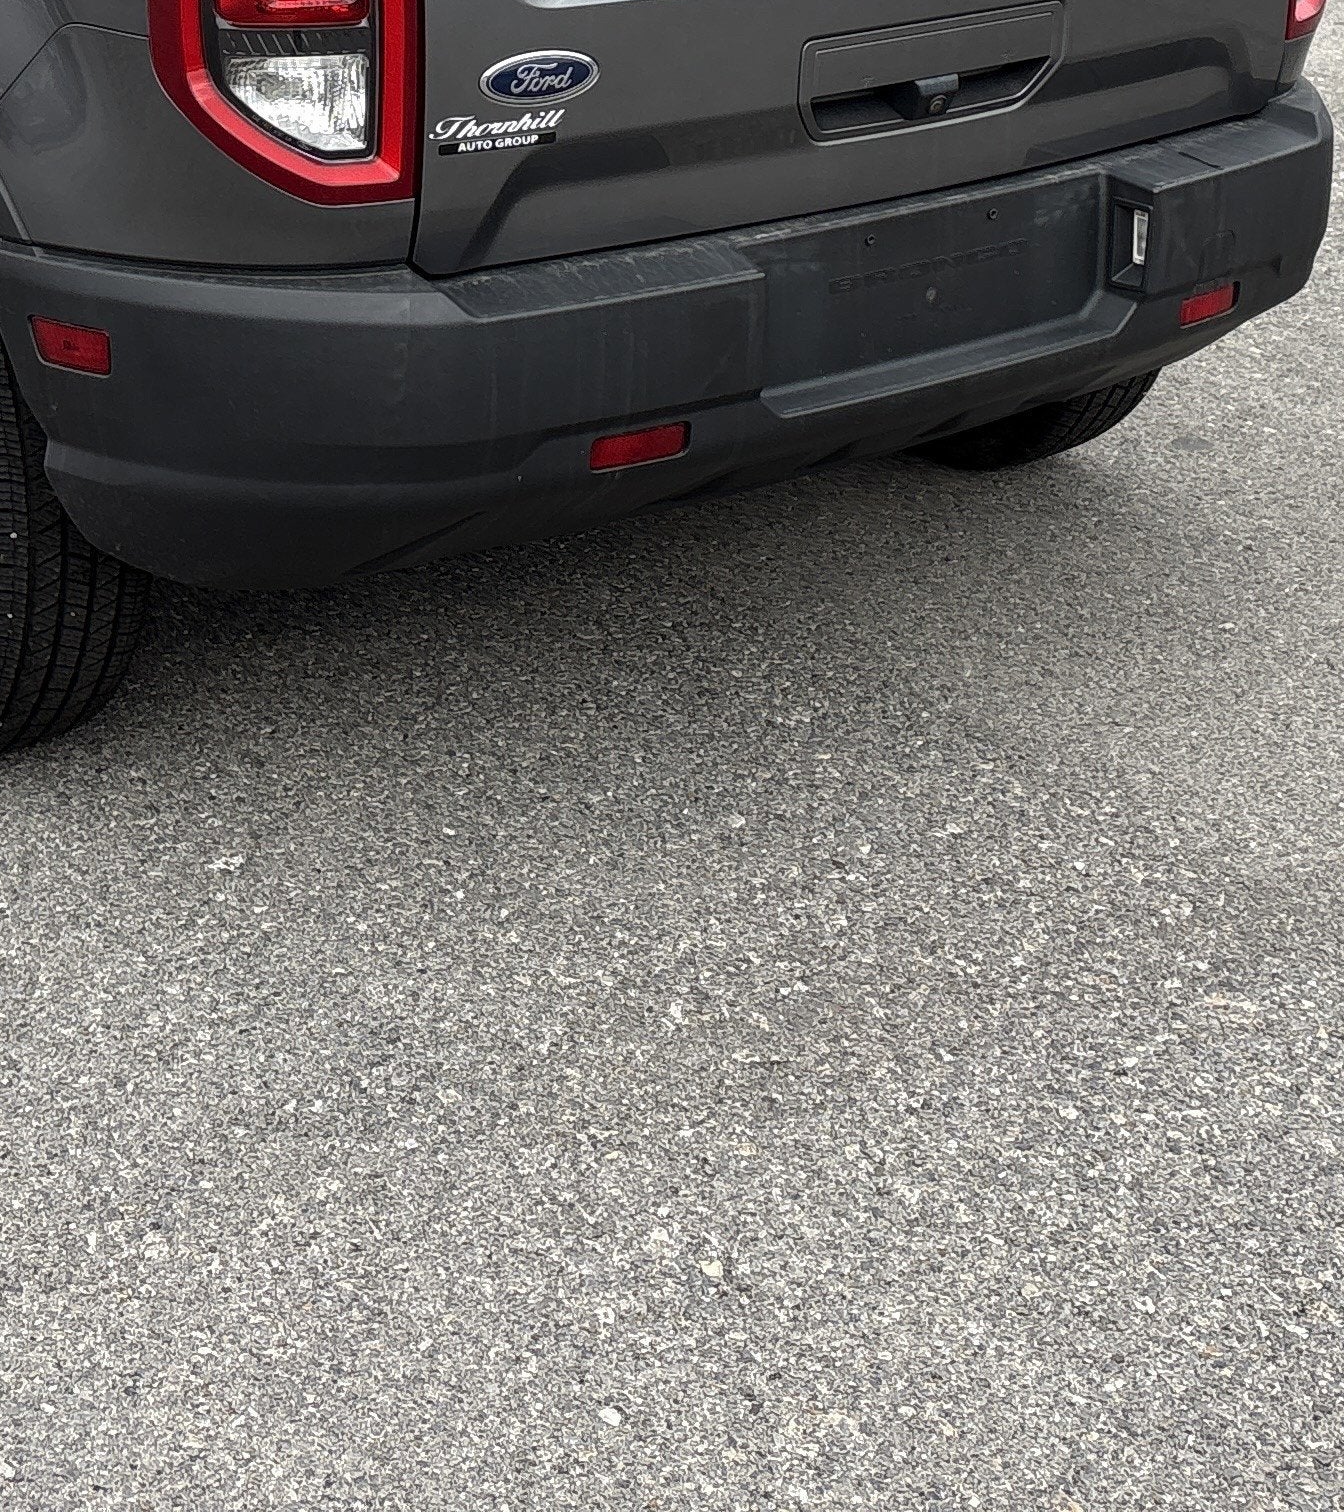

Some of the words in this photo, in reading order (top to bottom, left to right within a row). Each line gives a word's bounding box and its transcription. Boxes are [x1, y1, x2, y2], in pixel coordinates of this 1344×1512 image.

[511, 63, 573, 93] Ford
[429, 109, 565, 139] Thornhill
[457, 139, 492, 153] AUTO
[495, 134, 539, 149] GROUP
[829, 238, 1028, 293] BRONCO
